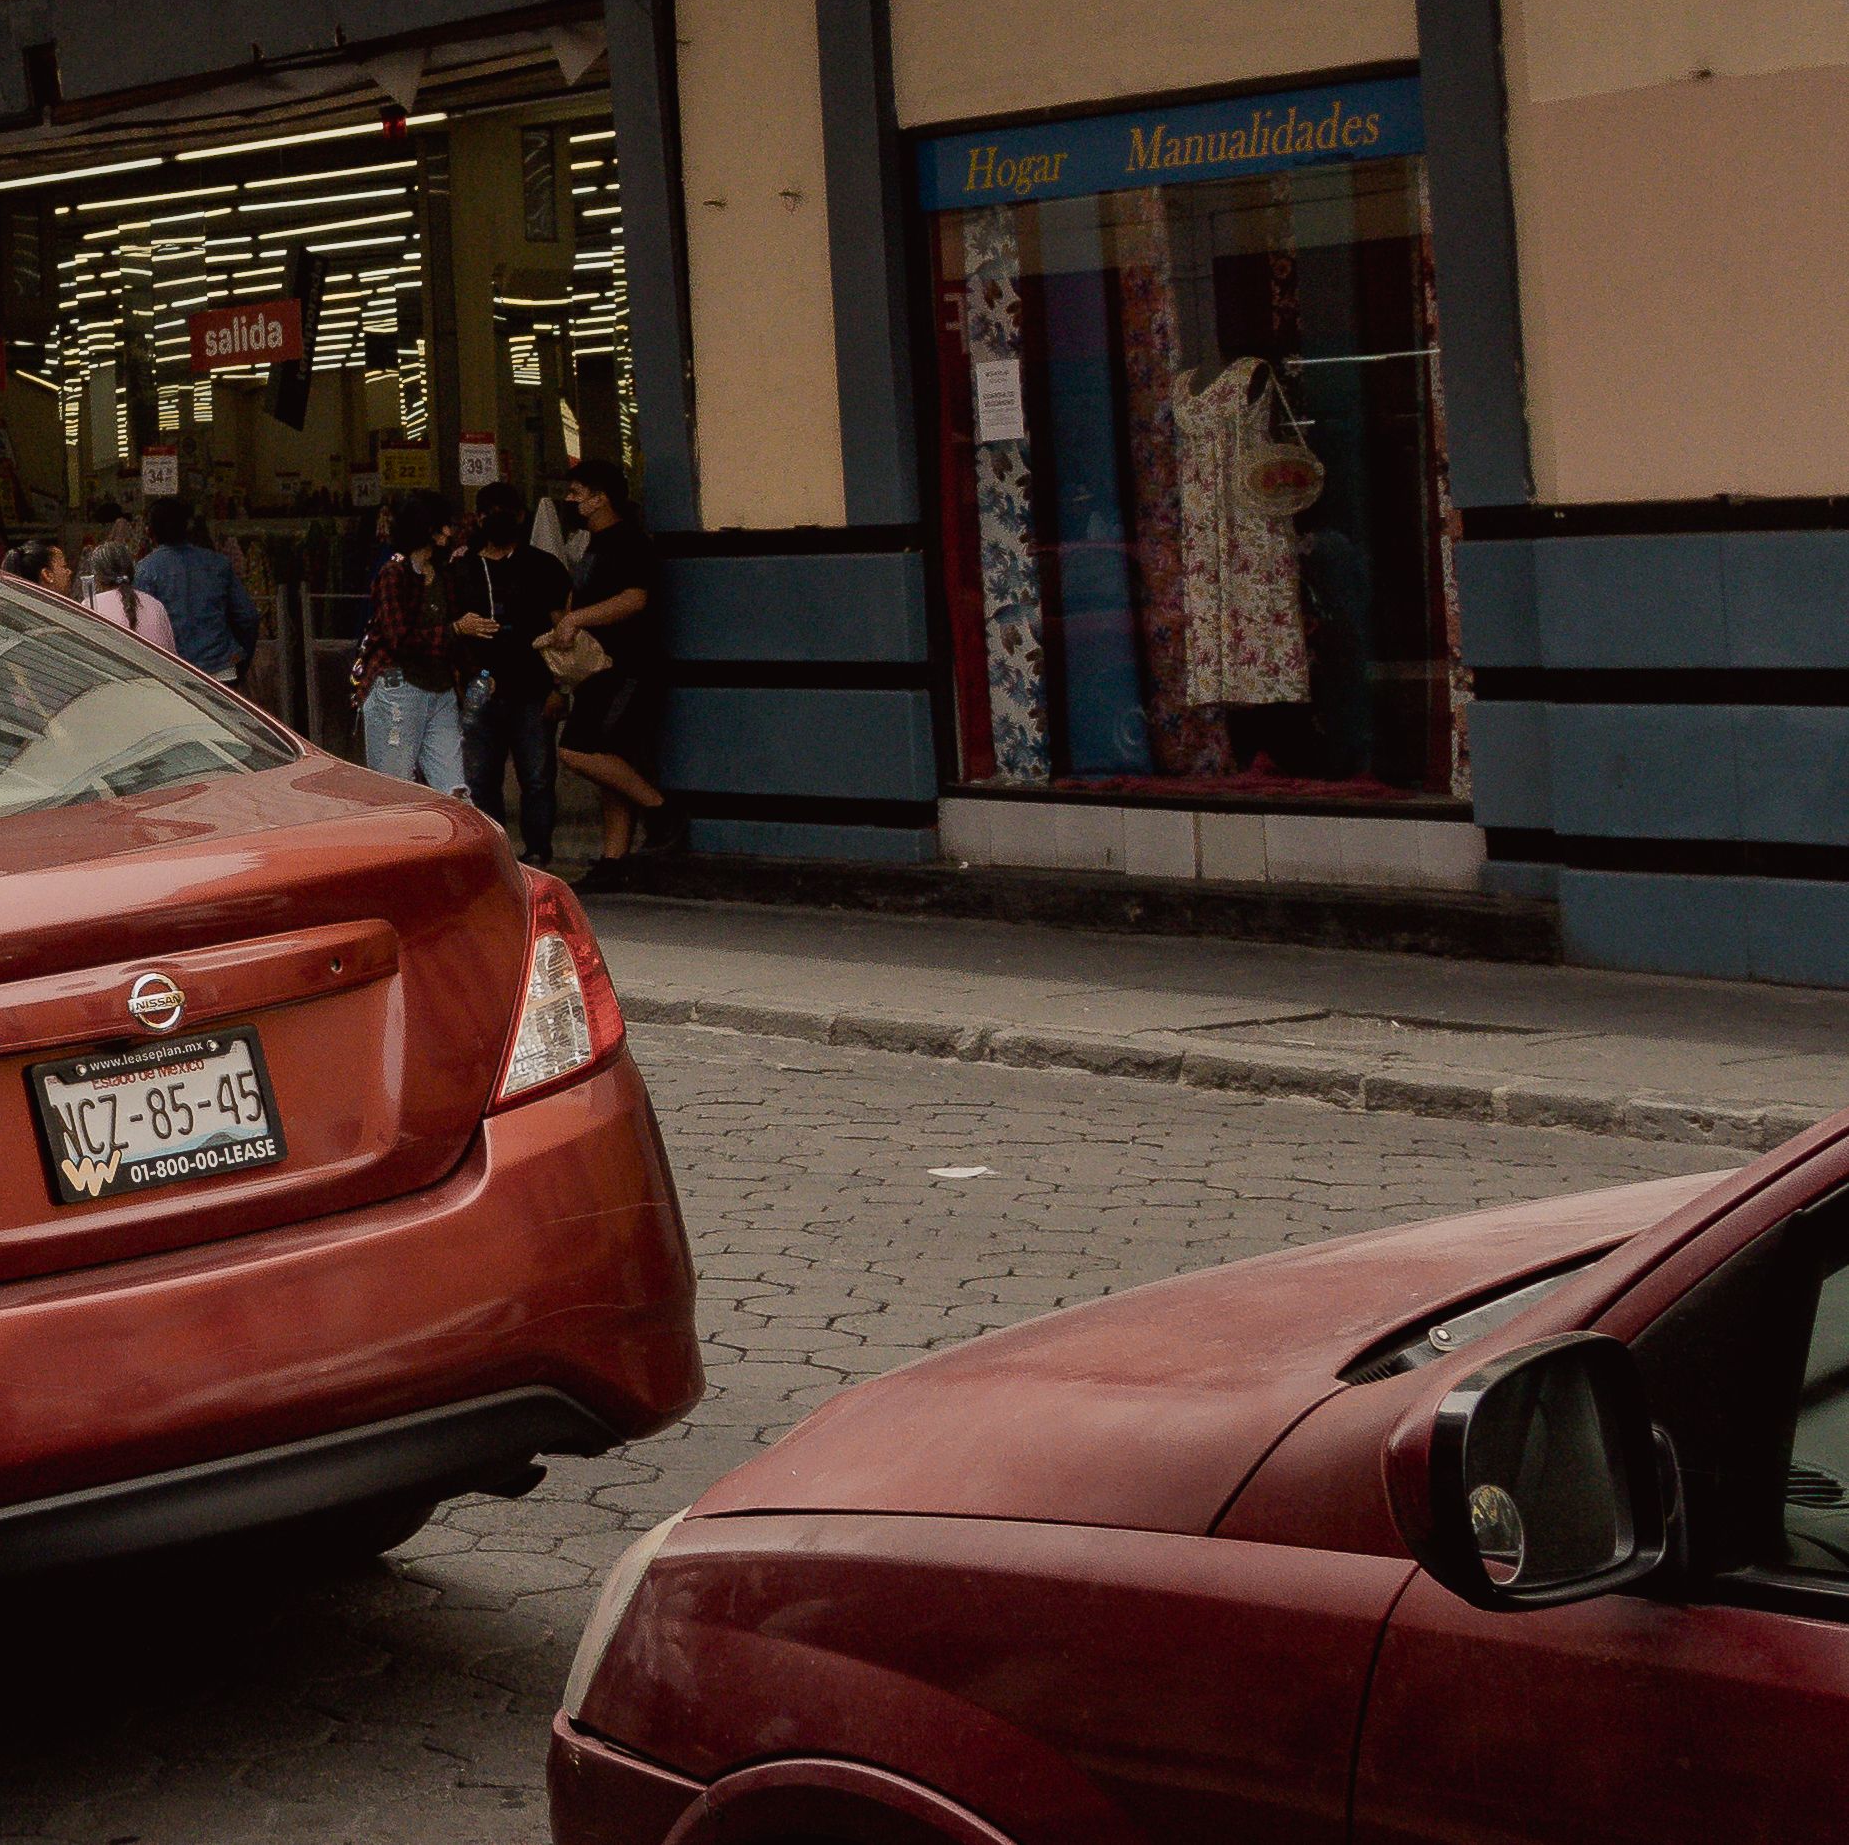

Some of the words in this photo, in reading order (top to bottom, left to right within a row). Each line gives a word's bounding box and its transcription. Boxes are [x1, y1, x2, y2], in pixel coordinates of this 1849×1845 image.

[964, 146, 1068, 195] Hogar
[1125, 100, 1382, 172] Manualidades
[205, 312, 283, 356] salida
[136, 994, 181, 1011] NISSAN
[90, 1041, 204, 1071] www.leaseplan.mx
[51, 1069, 262, 1157] NCZ-85-45
[130, 1138, 277, 1184] 01-800-00-LEASE
